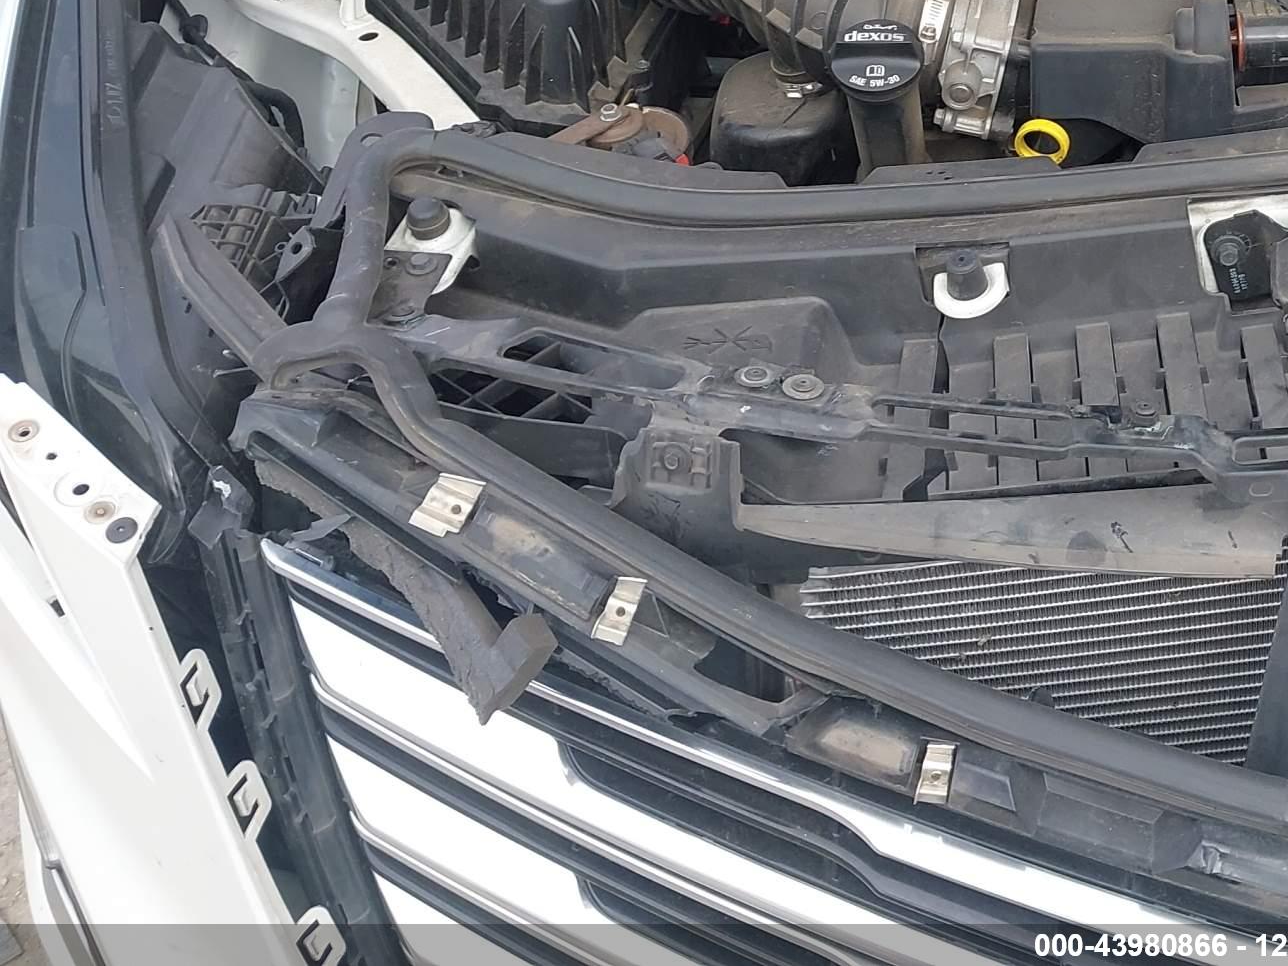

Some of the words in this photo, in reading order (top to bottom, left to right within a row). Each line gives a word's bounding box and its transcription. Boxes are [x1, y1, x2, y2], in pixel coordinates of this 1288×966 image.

[844, 30, 907, 42] dexos
[849, 74, 867, 86] SAE
[869, 74, 901, 87] 5W-30
